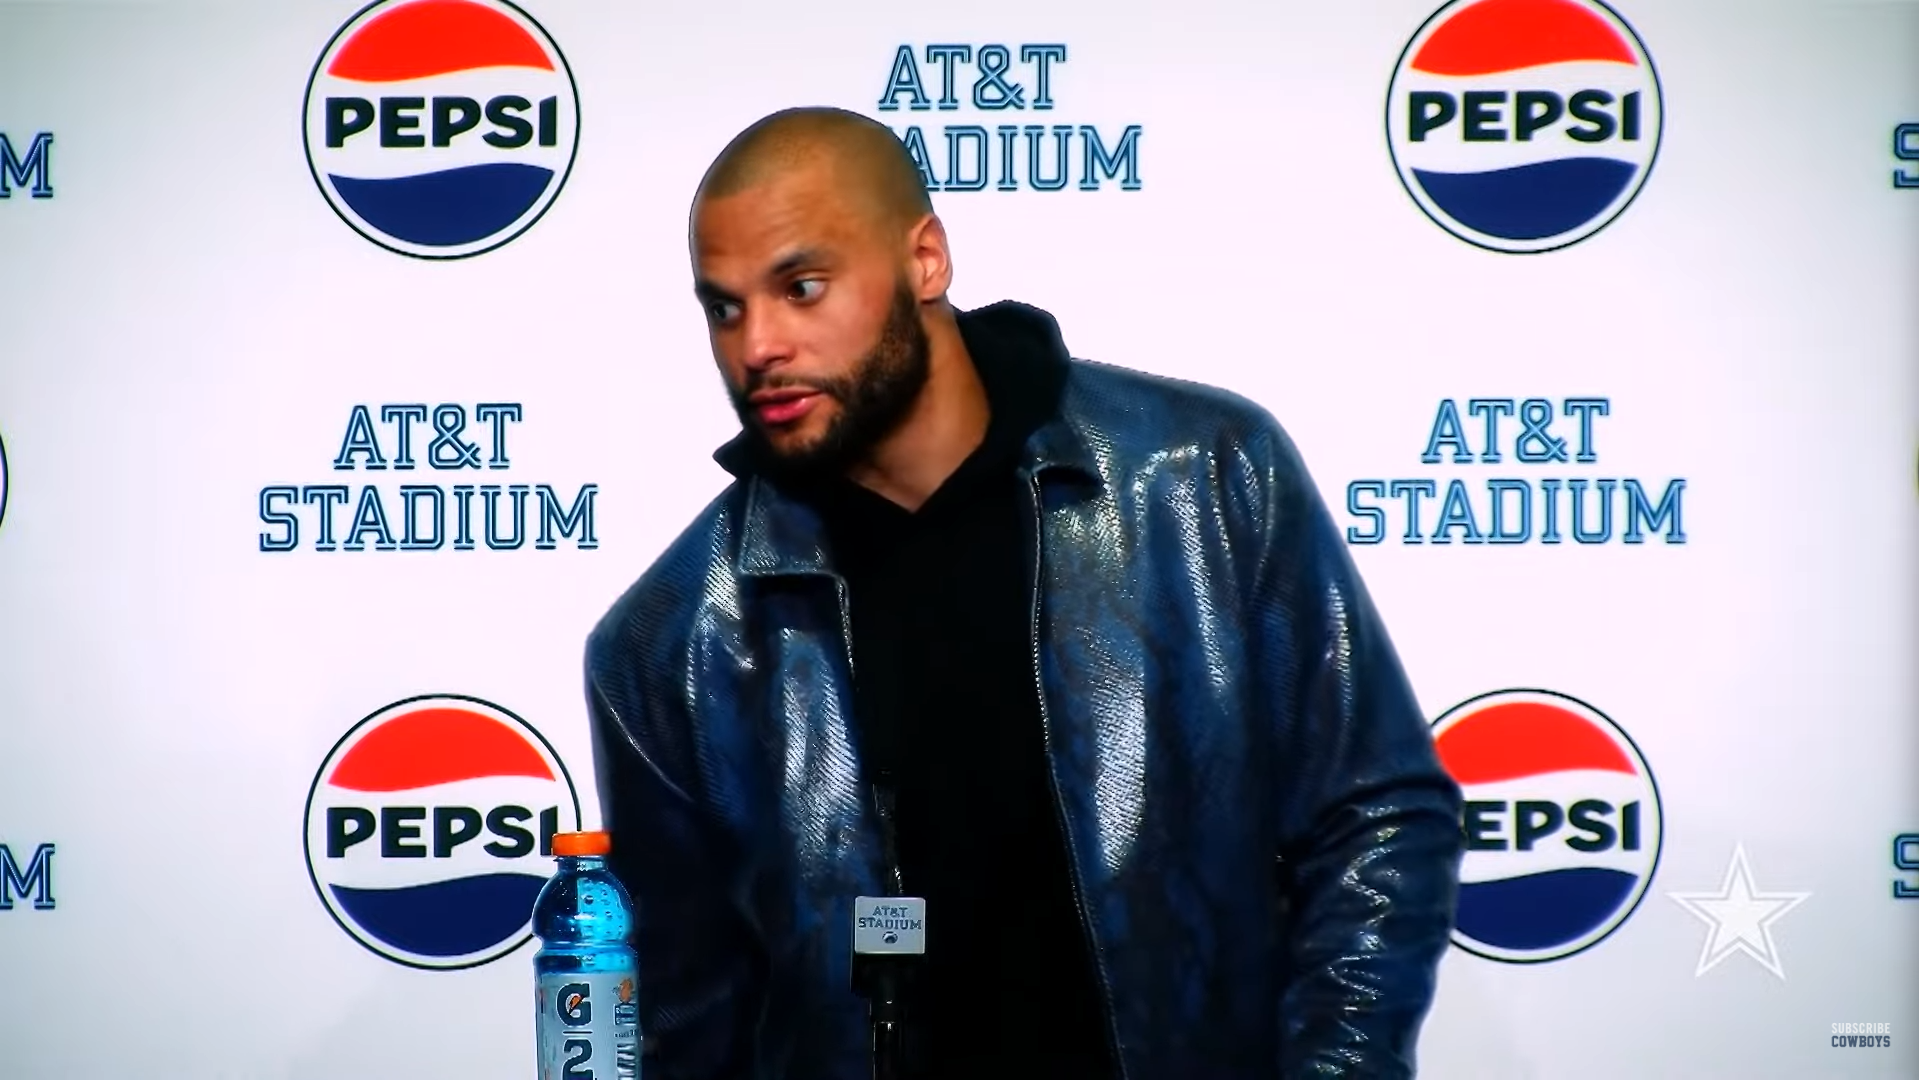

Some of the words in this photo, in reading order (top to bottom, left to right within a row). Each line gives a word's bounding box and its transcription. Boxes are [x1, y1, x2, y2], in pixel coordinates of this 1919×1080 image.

[877, 43, 1068, 112] AT&T
[325, 94, 558, 150] PEPSI
[1407, 88, 1641, 144] PEPSI
[903, 125, 1143, 192] ADIUM
[333, 402, 523, 471] AT&T
[1420, 396, 1611, 465] AT&T
[258, 483, 599, 553] STADIUM
[1346, 477, 1687, 549] STADIUM
[326, 804, 558, 859] PEPSI
[1465, 798, 1641, 854] EPSI
[858, 916, 922, 930] STADIUM
[872, 905, 908, 918] AT&T
